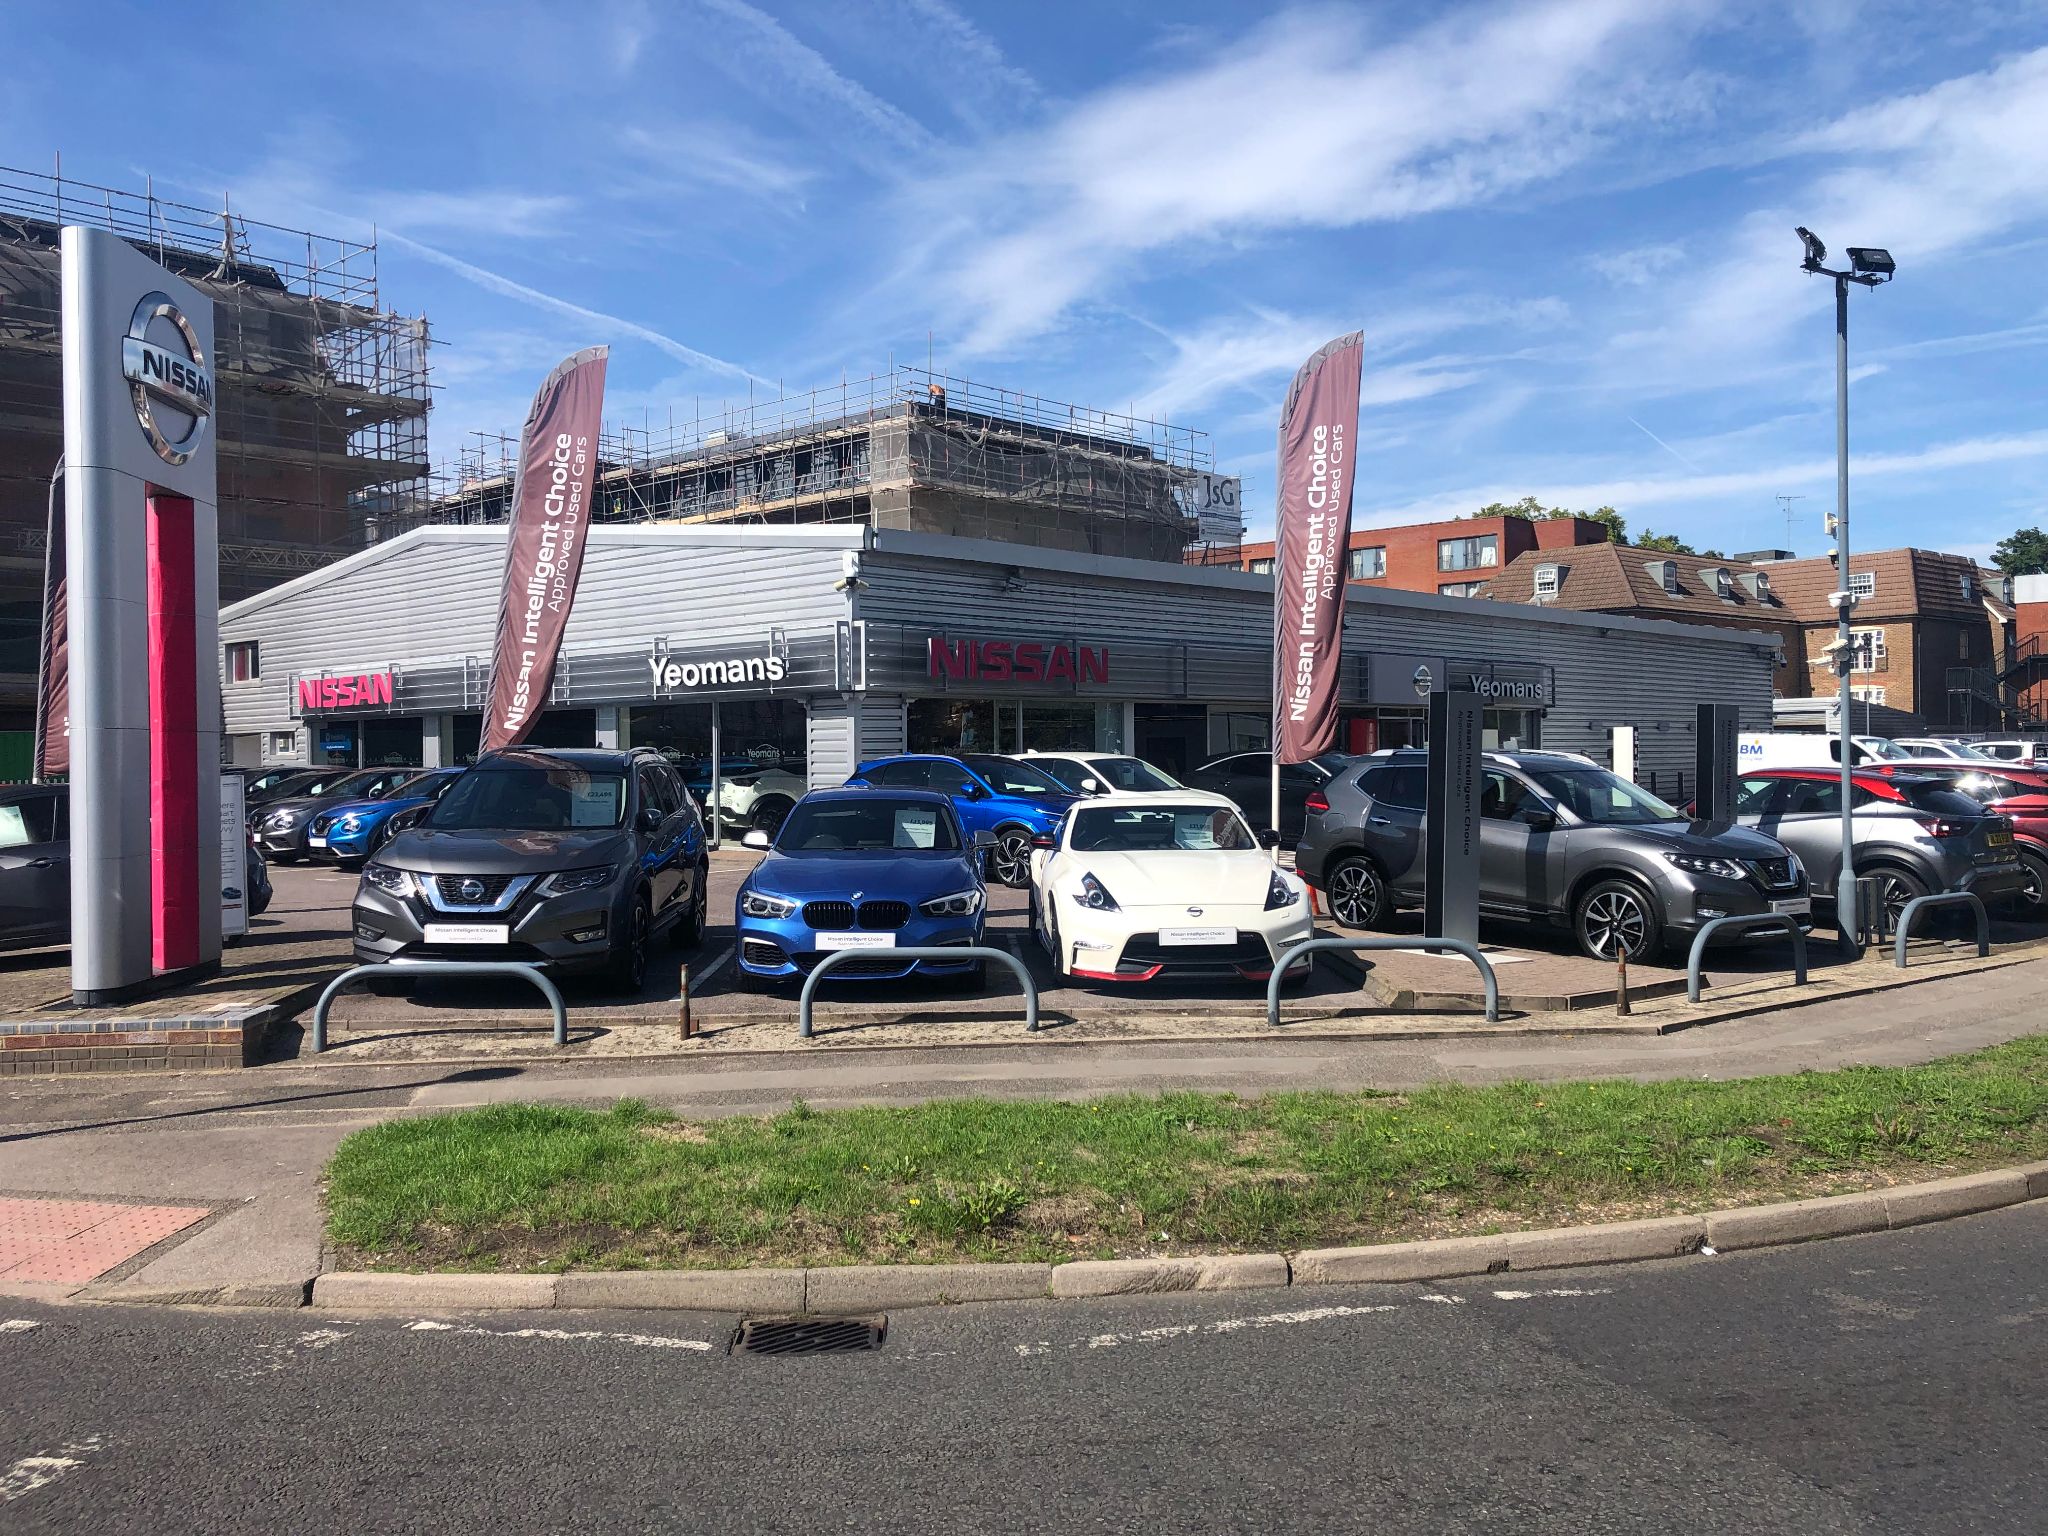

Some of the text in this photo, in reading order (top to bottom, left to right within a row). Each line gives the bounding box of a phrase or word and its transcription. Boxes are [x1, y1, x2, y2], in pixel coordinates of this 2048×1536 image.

[143, 349, 213, 407] NISSAN
[547, 436, 587, 613] Approved Used Cars
[1320, 424, 1343, 600] Approved Used Cars
[503, 433, 572, 731] Nissan Intelligent Choice
[1289, 425, 1328, 722] Nissan Intelligent Choice
[648, 656, 784, 687] Yeomans
[927, 637, 1109, 684] NISSAN
[1471, 674, 1543, 699] Yeomans
[299, 671, 393, 710] NISSAN
[747, 748, 780, 759] Yeomans
[1739, 744, 1763, 755] BM
[1463, 710, 1474, 856] Nissan Intelligent Choice
